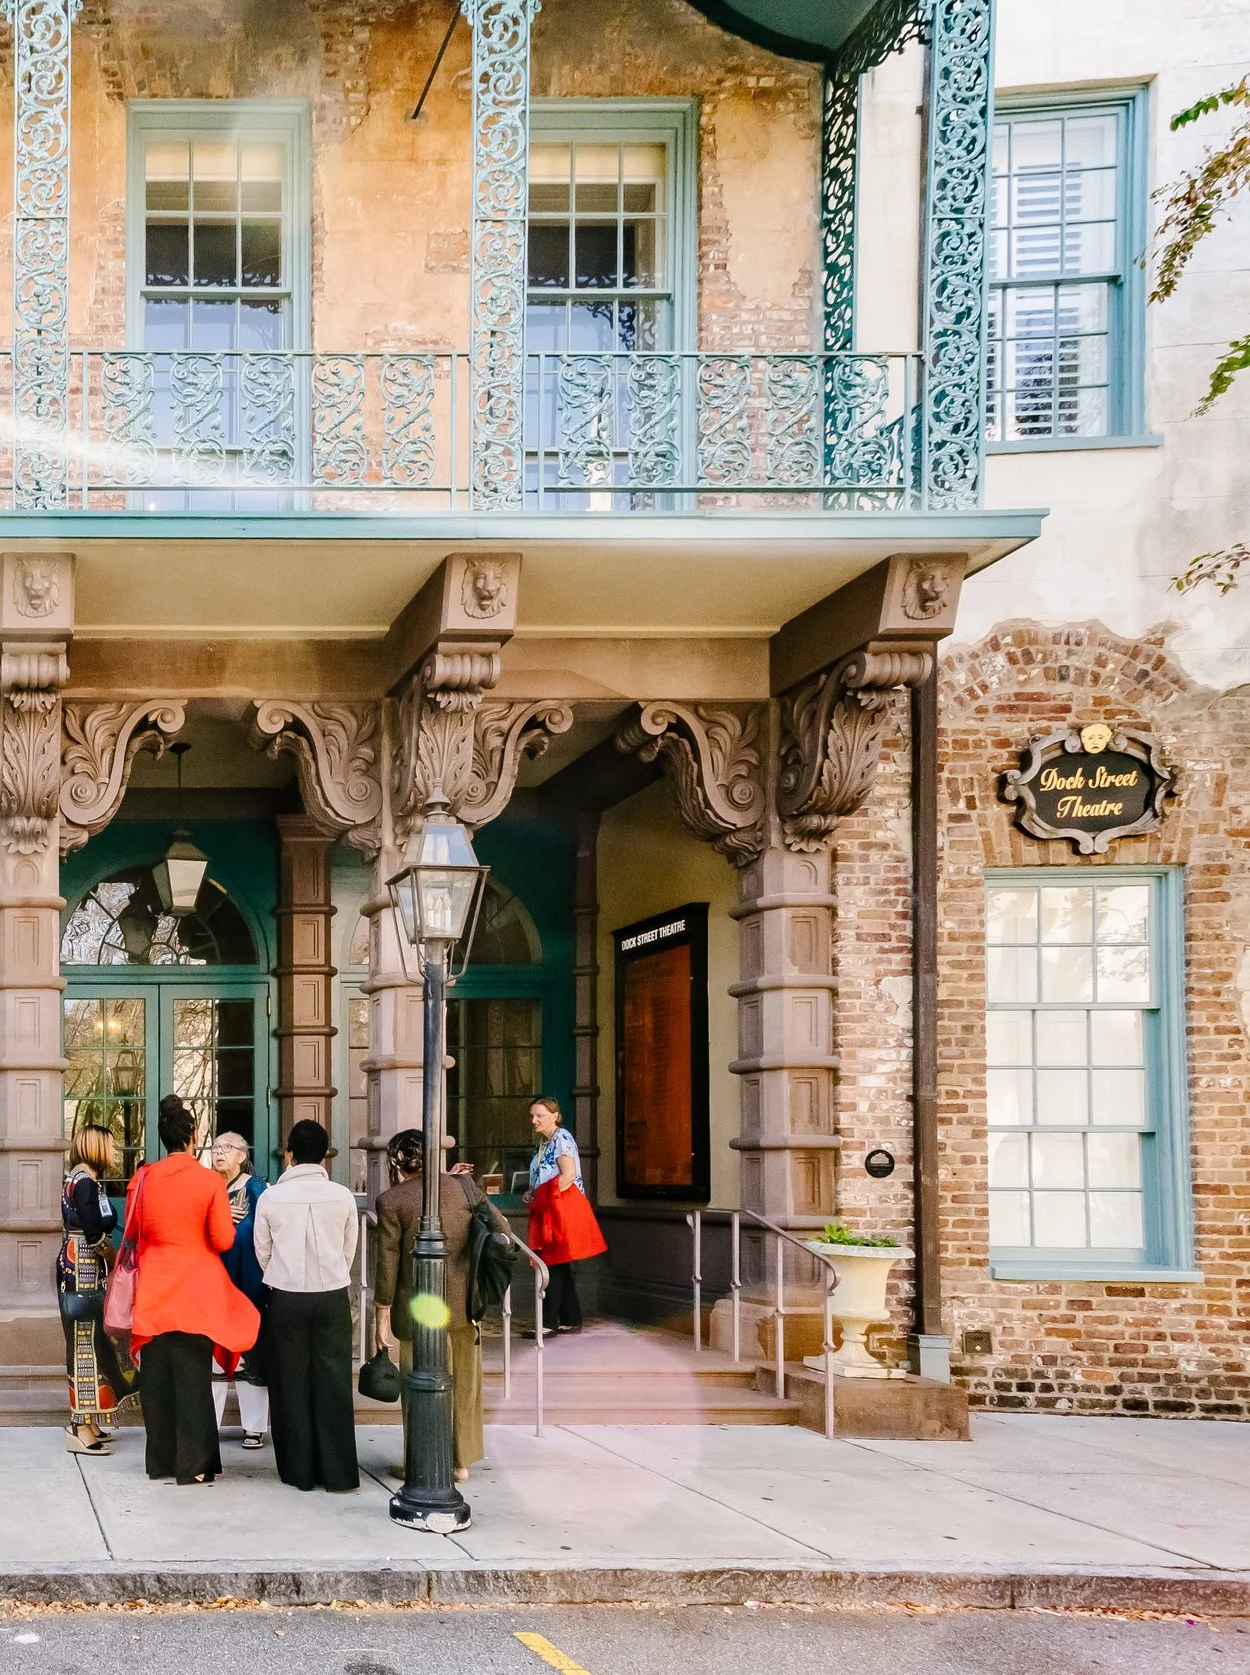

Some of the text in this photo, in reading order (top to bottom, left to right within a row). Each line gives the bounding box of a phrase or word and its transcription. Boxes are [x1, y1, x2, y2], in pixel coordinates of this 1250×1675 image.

[1040, 766, 1139, 792] Dock Street
[1056, 795, 1123, 819] Theatre
[621, 919, 686, 951] DOCK STREET THEATRE
